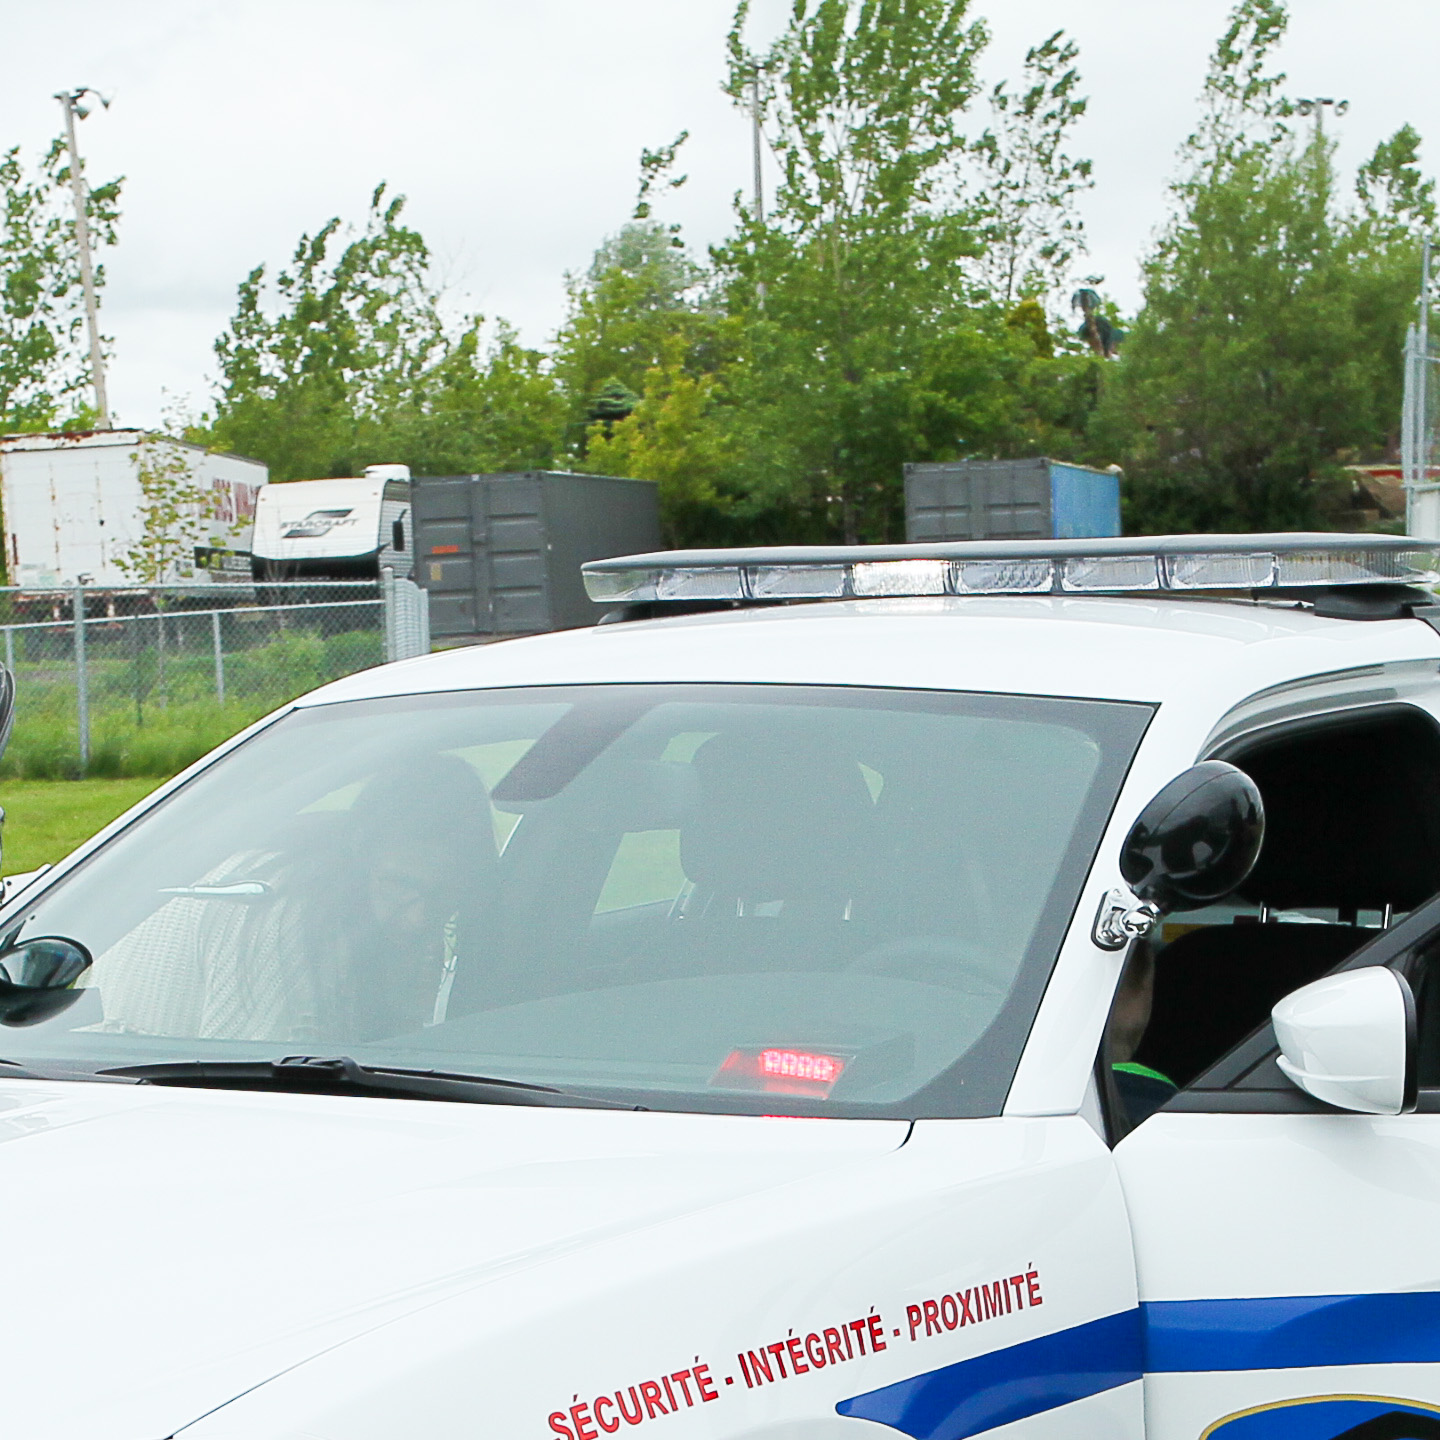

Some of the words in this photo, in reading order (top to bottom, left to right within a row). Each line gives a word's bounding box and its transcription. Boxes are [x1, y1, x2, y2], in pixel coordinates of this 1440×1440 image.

[280, 518, 360, 530] STARCRAFT
[738, 1306, 888, 1389] INTÉGRITÉ
[906, 1261, 1044, 1342] PROXIMITÉ
